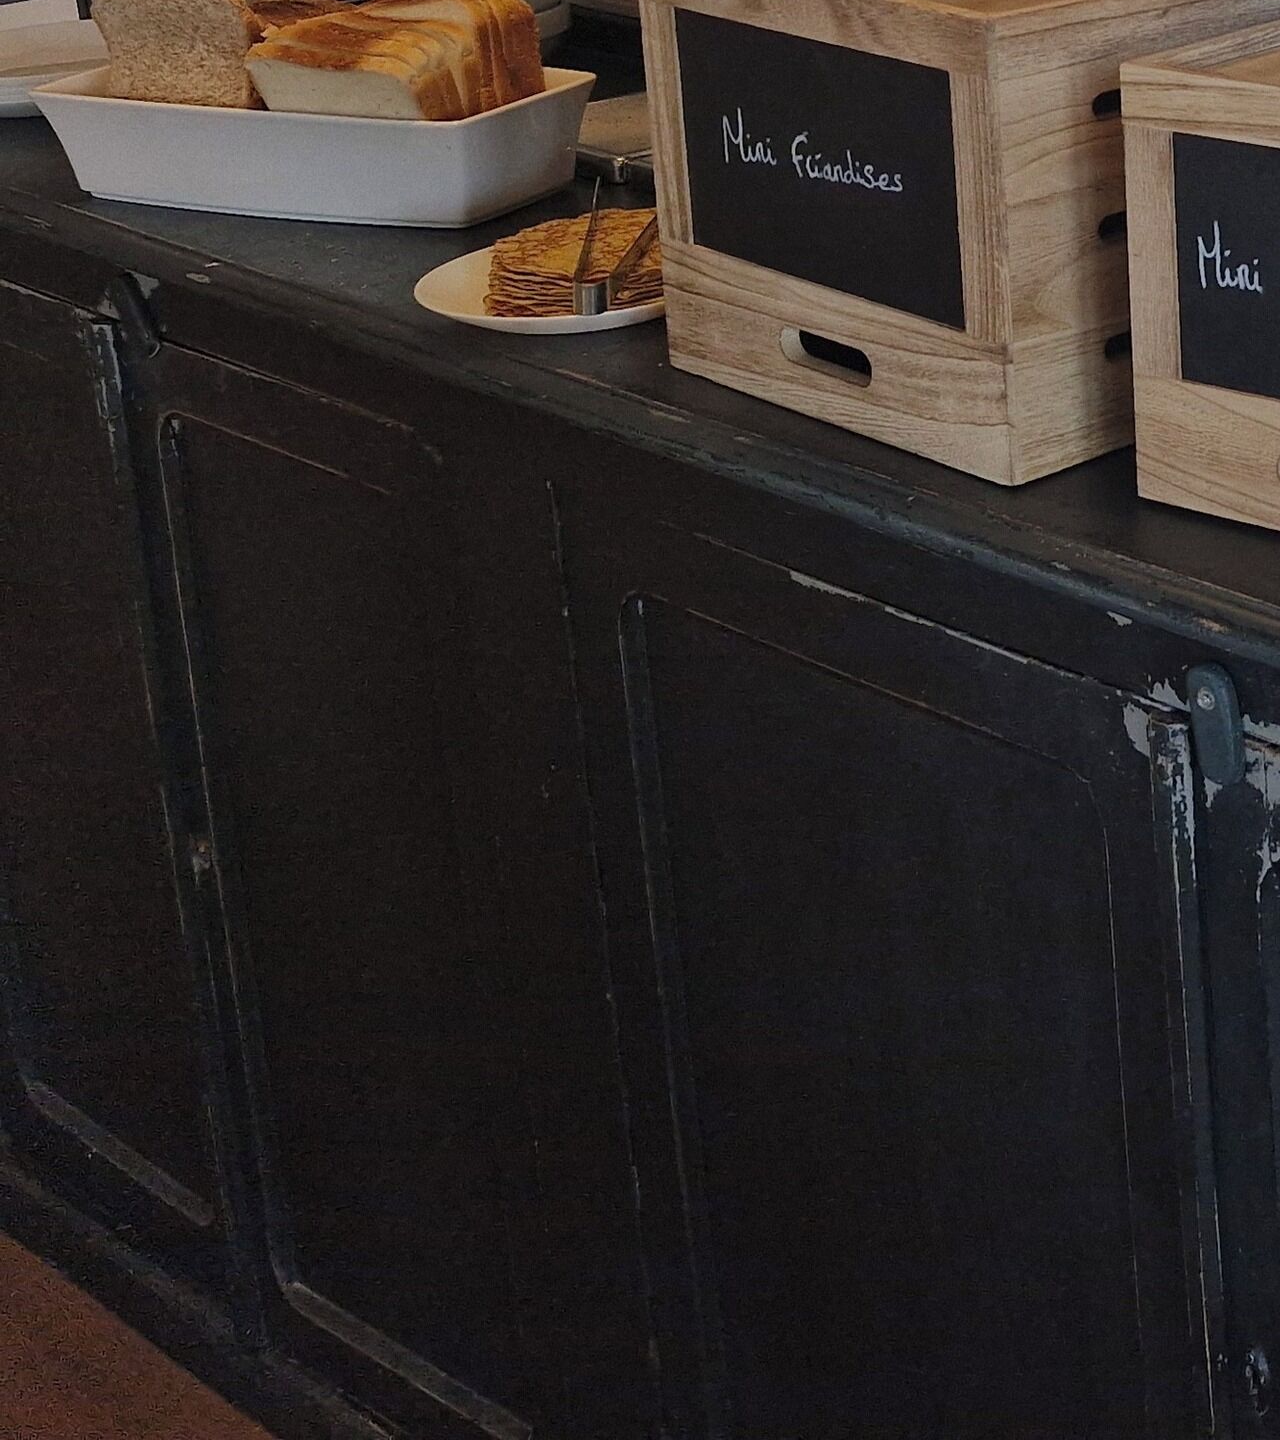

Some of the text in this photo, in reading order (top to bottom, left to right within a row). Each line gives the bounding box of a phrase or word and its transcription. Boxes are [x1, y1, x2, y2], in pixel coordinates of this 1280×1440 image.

[722, 107, 903, 193] Mini Friandises
[1196, 220, 1264, 294] Mini
